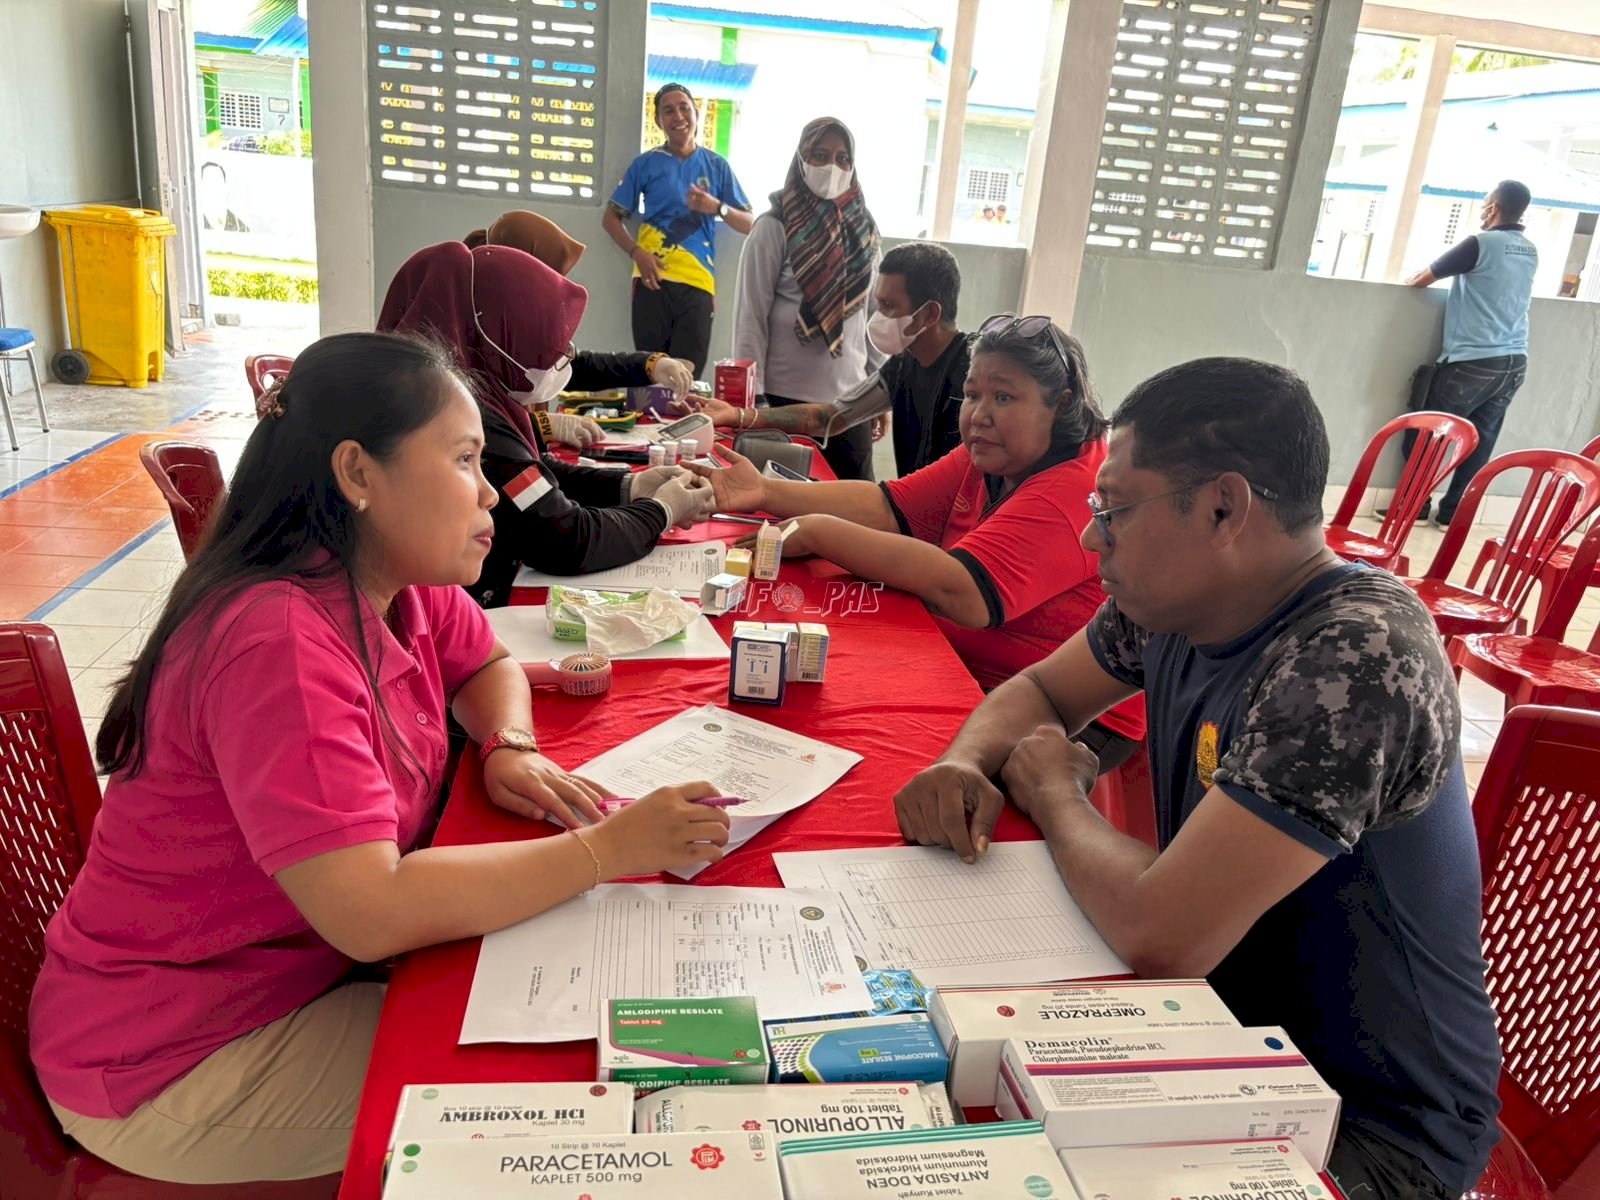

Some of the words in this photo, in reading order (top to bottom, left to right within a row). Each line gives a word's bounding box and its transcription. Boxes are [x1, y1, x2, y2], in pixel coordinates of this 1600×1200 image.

[1040, 1008, 1146, 1020] OMEPRAZOLE
[1024, 1036, 1107, 1049] Demacolin
[862, 1054, 893, 1064] BESILATE
[894, 1052, 938, 1062] AMLODIPINE
[1099, 1052, 1130, 1061] maleate
[820, 1104, 840, 1114] mg
[842, 1104, 864, 1114] 100
[866, 1104, 902, 1114] Tablet
[440, 1109, 548, 1122] AMBROXOL
[532, 1119, 556, 1128] Kaplet
[572, 1120, 586, 1128] mg
[766, 1116, 906, 1134] ALLOPURINOL
[561, 1142, 579, 1150] Strip
[602, 1140, 626, 1149] Kaplet
[856, 1154, 918, 1166] Hidroksida
[921, 1149, 985, 1161] Magnesium
[500, 1152, 672, 1172] PARACETAMOL
[926, 1158, 988, 1170] Alumunium
[859, 1163, 923, 1176] Hidroksida
[531, 1174, 582, 1185] KAPLET
[586, 1172, 614, 1182] 500
[618, 1172, 642, 1184] mg
[867, 1175, 914, 1190] DOEN
[917, 1170, 990, 1184] ANTASIDA
[1229, 1180, 1246, 1191] mg
[1249, 1182, 1268, 1191] 100
[1268, 1179, 1302, 1190] Tablet
[898, 1189, 930, 1198] Kunyah
[932, 1188, 963, 1196] Tablet
